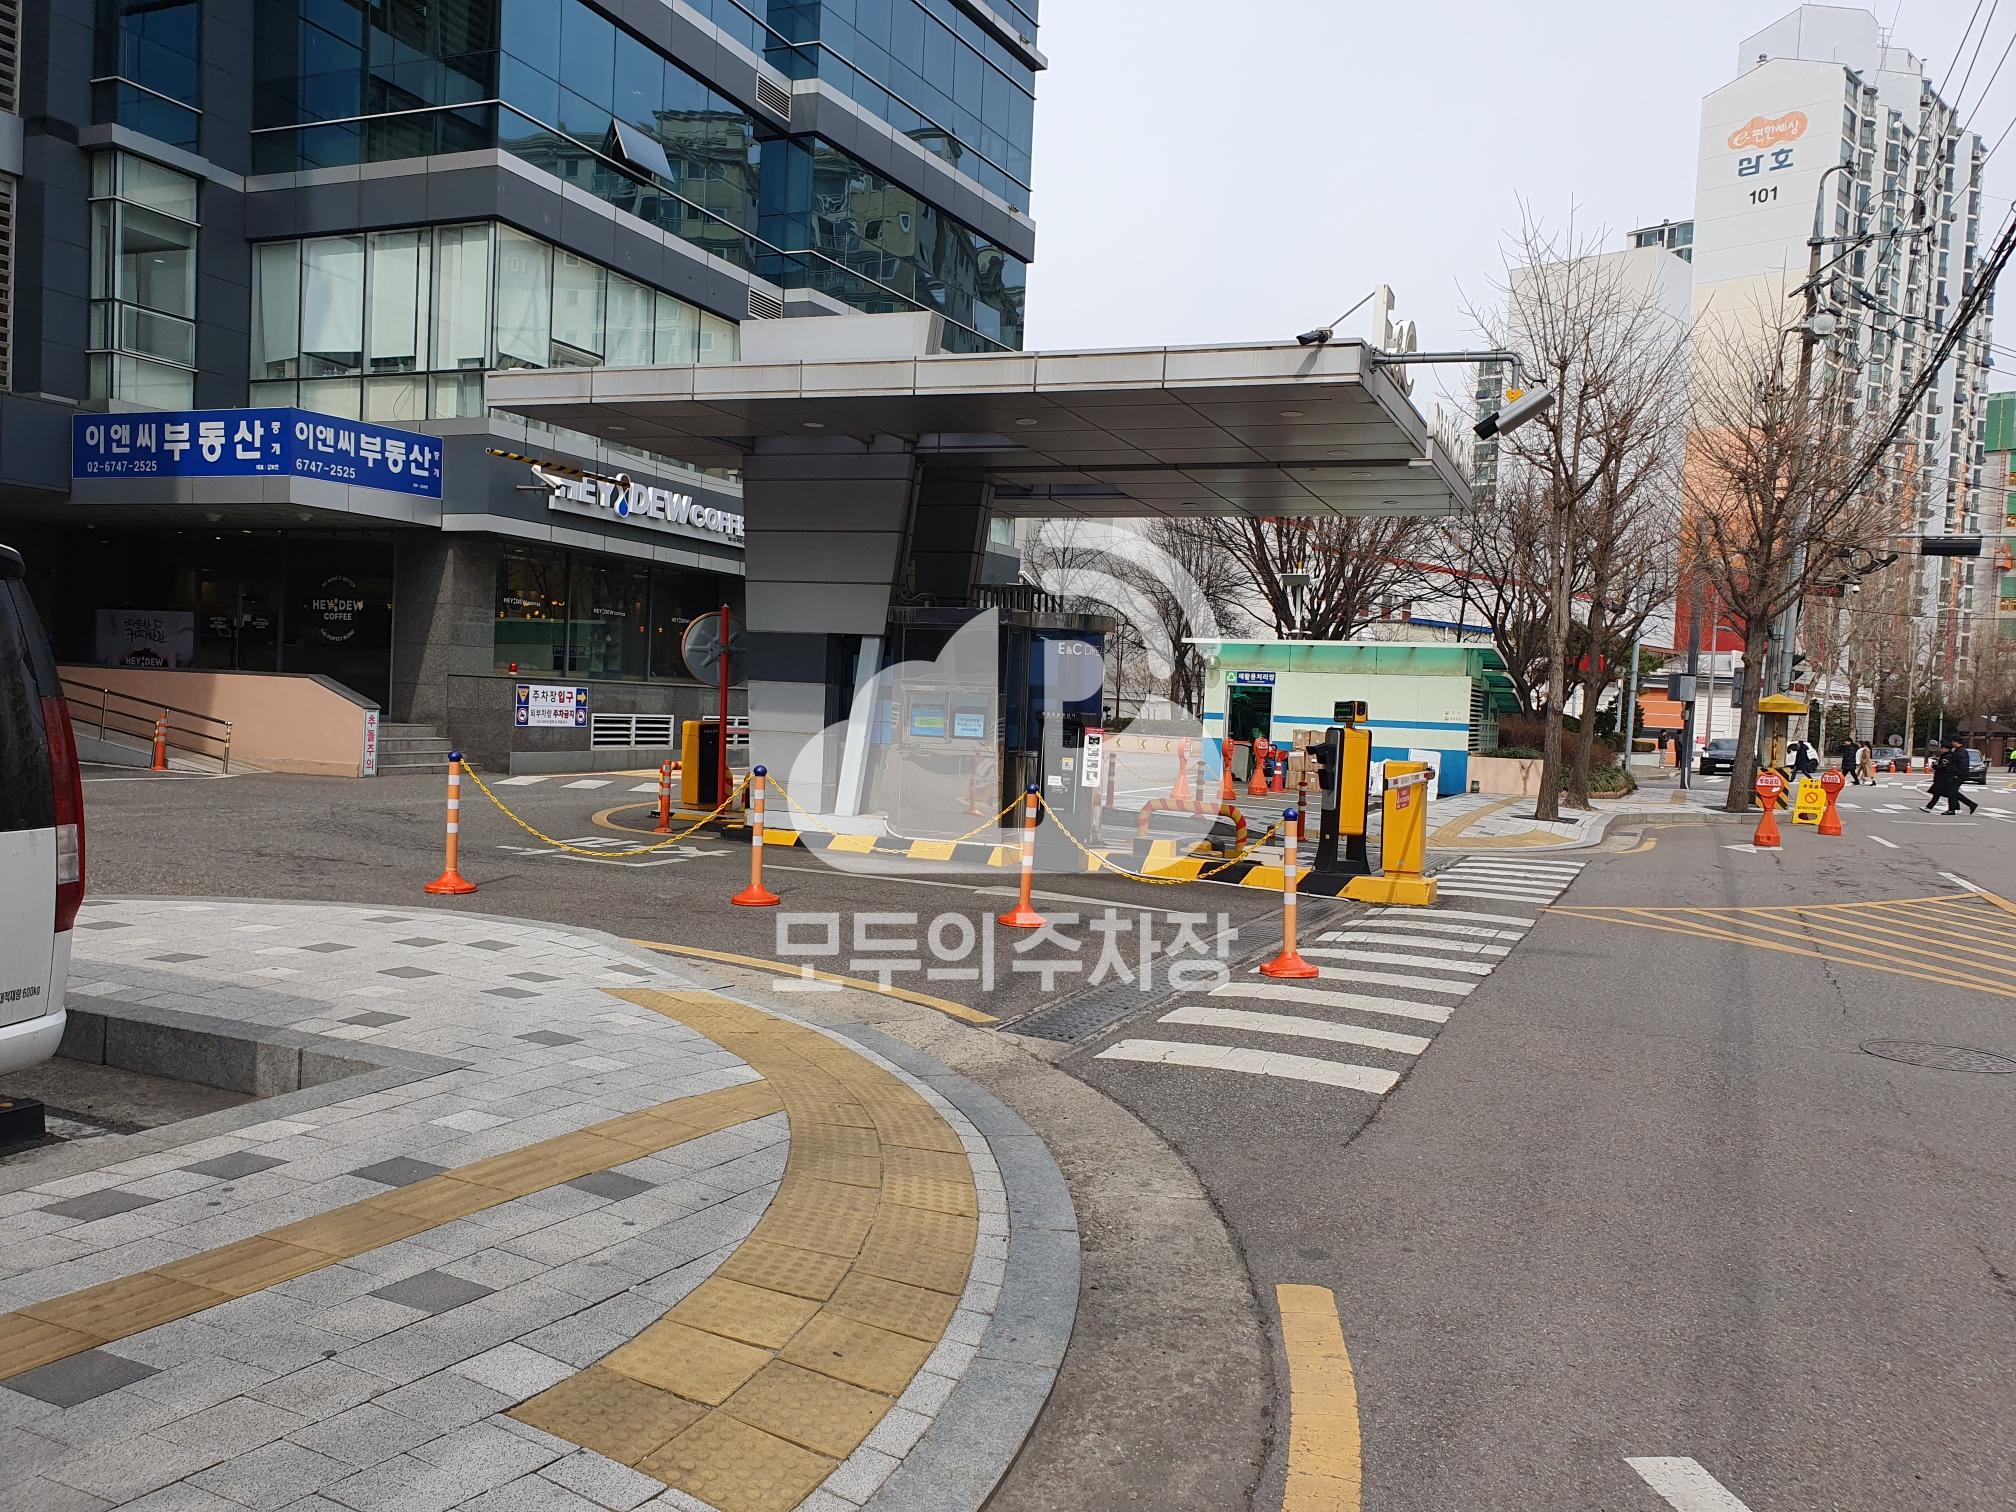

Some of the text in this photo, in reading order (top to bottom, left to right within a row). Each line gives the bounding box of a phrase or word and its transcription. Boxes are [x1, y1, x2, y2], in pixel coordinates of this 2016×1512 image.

[1749, 185, 1778, 205] 101
[87, 461, 157, 473] 02-6747-2525
[296, 459, 356, 479] 6747-2525
[689, 504, 745, 537] COFFE
[323, 612, 353, 621] COFFEE
[144, 657, 163, 667] DEW
[553, 709, 575, 719] 주차금지
[365, 714, 376, 771] 추돌주의
[22, 985, 41, 999] 600kg
